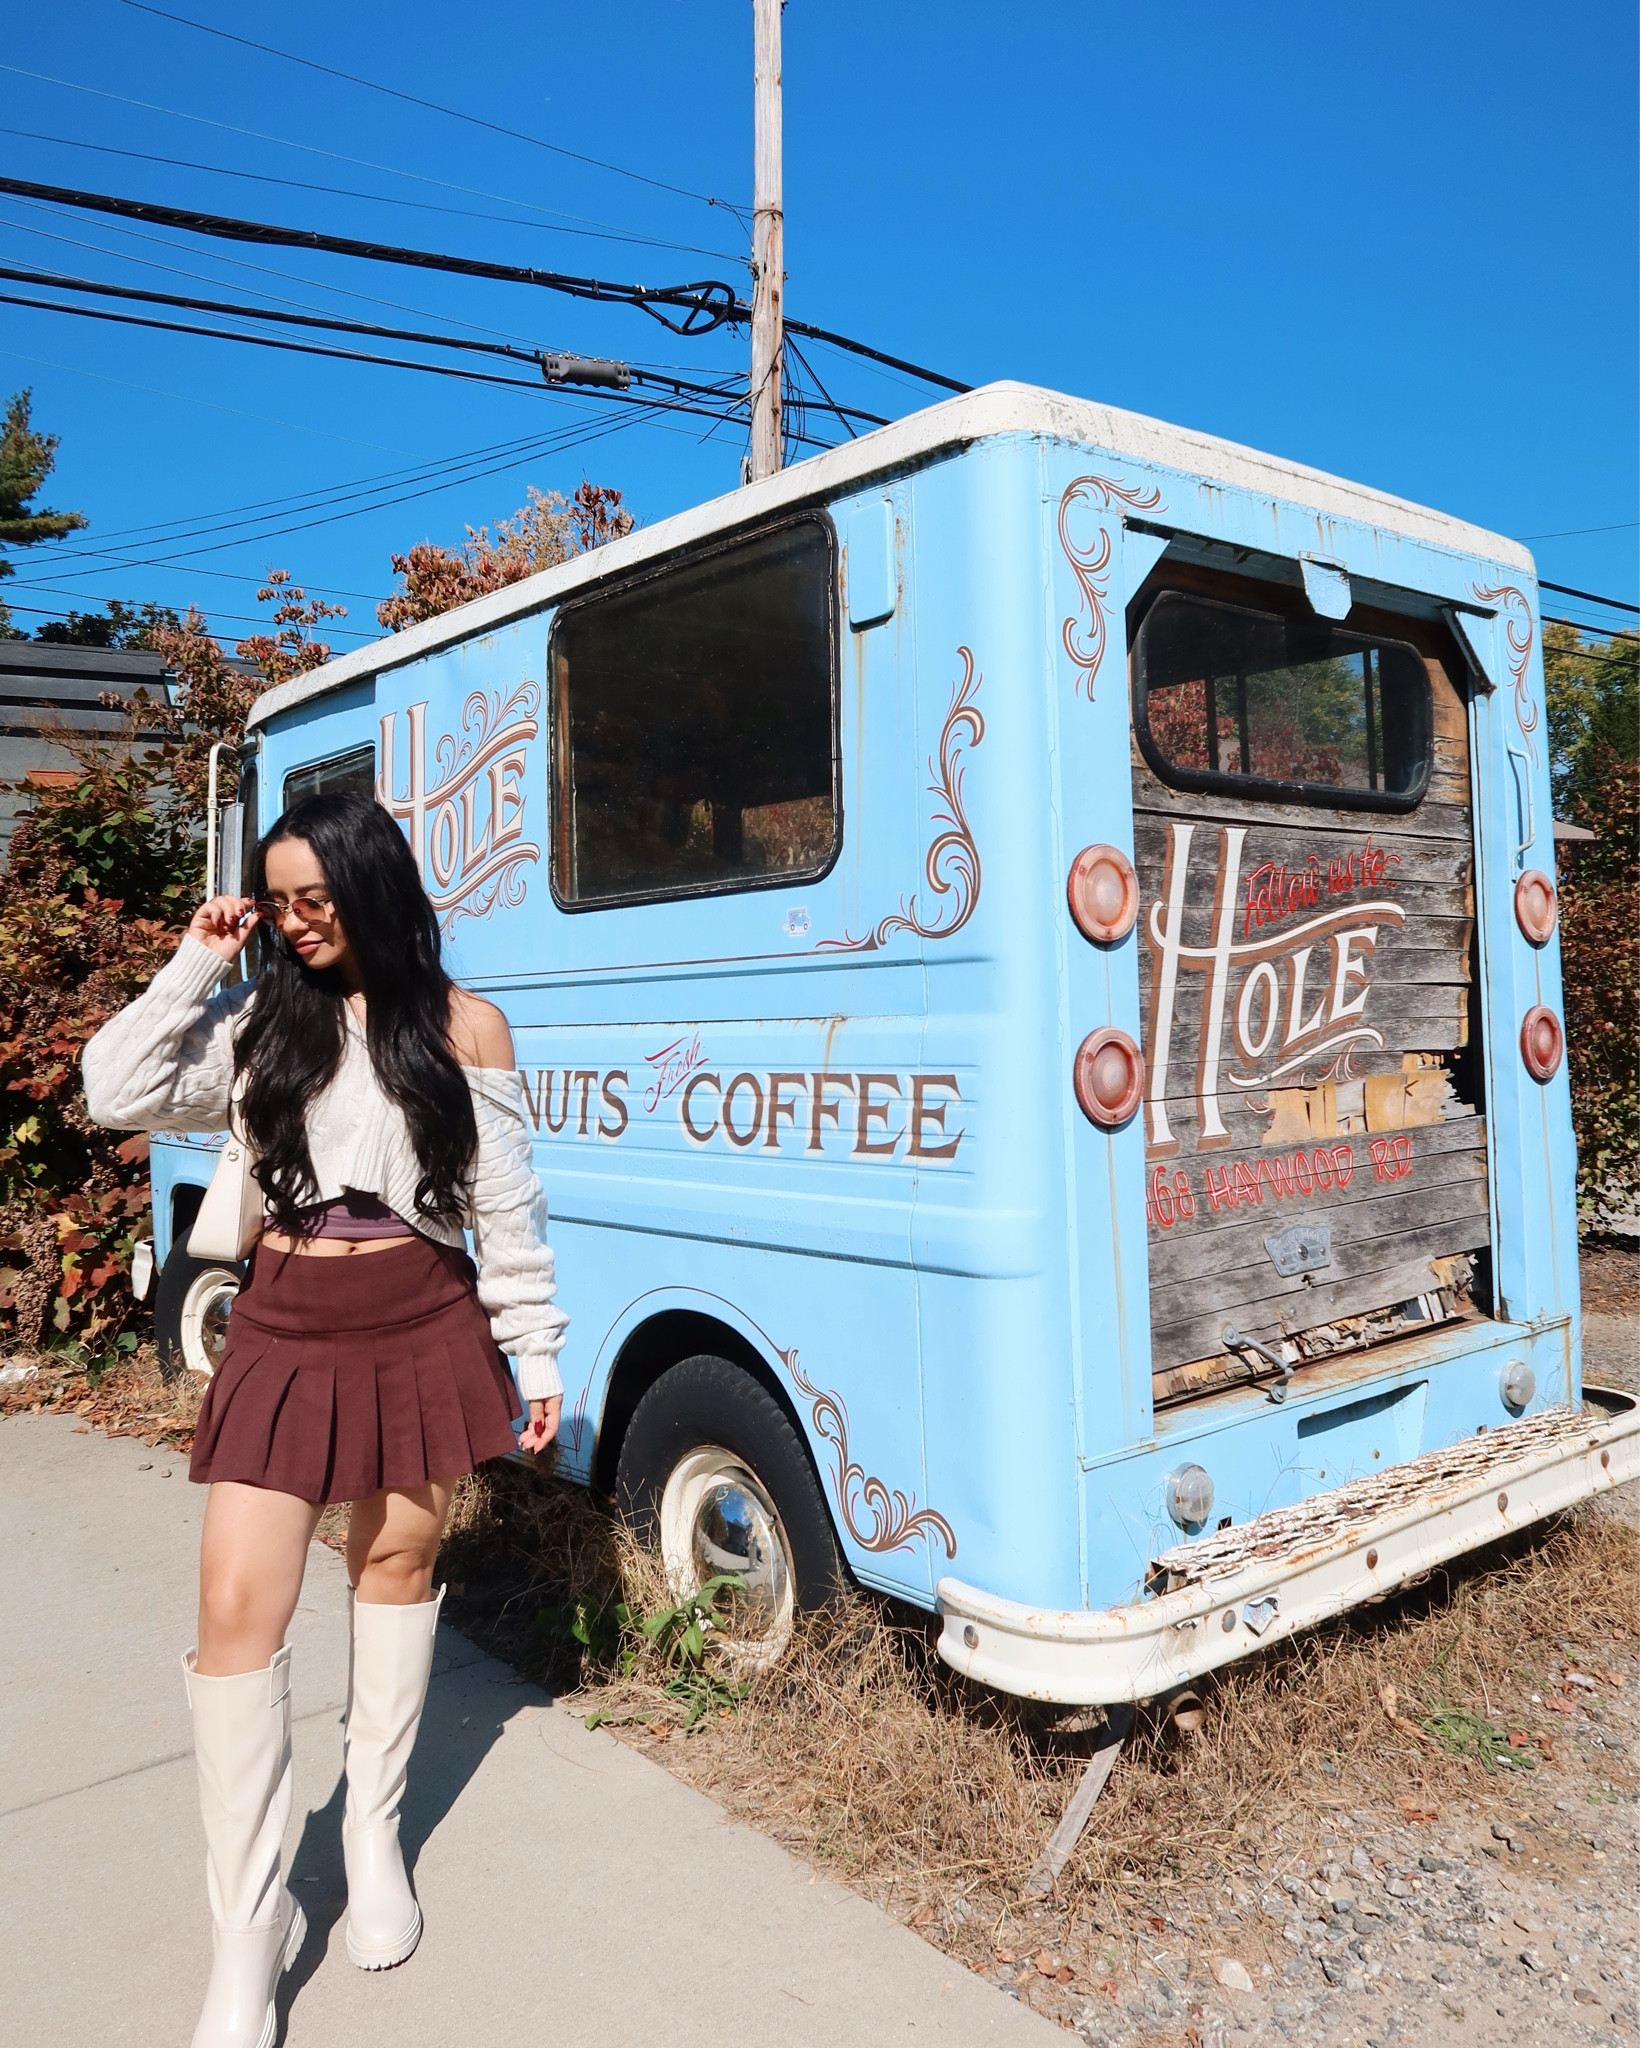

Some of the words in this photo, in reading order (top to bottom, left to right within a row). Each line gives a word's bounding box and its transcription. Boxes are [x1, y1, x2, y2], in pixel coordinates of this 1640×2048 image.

[375, 700, 538, 888] HOLE
[1244, 854, 1321, 937] Follow
[1328, 851, 1354, 894] us
[1146, 823, 1405, 1157] HOLE
[518, 1069, 629, 1141] NUTS
[679, 1072, 965, 1162] COFFEE
[643, 1031, 710, 1113] Fresh
[1205, 1144, 1354, 1210] HAYWOOD
